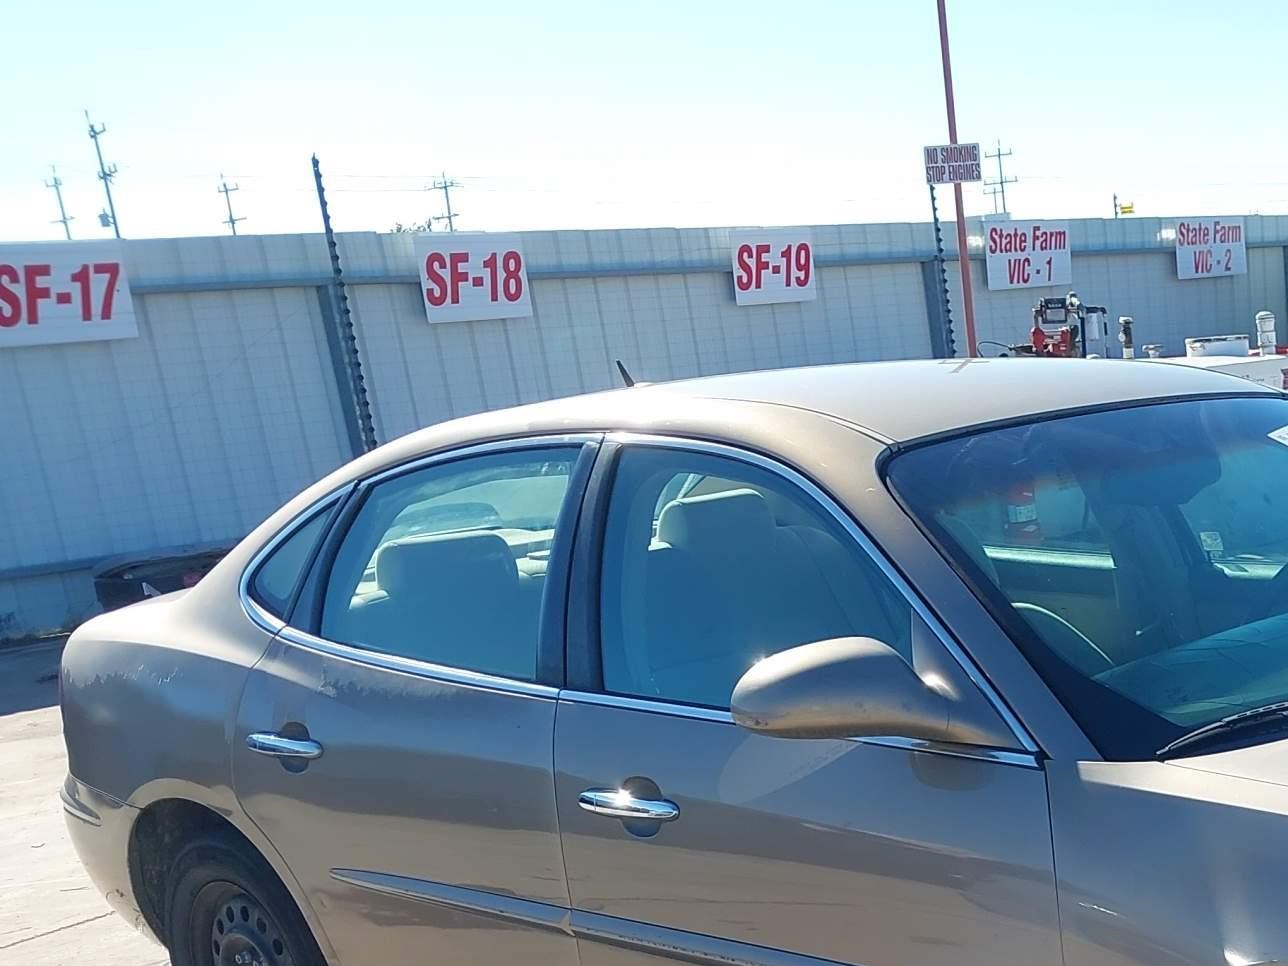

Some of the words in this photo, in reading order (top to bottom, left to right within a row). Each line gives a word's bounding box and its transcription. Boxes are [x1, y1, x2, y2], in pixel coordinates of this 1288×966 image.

[926, 147, 939, 165] NO
[940, 145, 978, 164] SMOKING
[926, 165, 946, 184] STOP
[948, 162, 981, 181] ENGINES
[989, 227, 1027, 254] State
[1032, 225, 1066, 251] Farm
[1178, 222, 1209, 246] State
[1213, 220, 1242, 244] Farm
[736, 242, 811, 292] SF-19
[1007, 257, 1031, 284] VIC
[1045, 256, 1053, 282] 1
[1193, 249, 1213, 274] VIC
[1223, 248, 1232, 272] 2
[425, 250, 523, 307] SF-18
[0, 262, 120, 328] SF-17
